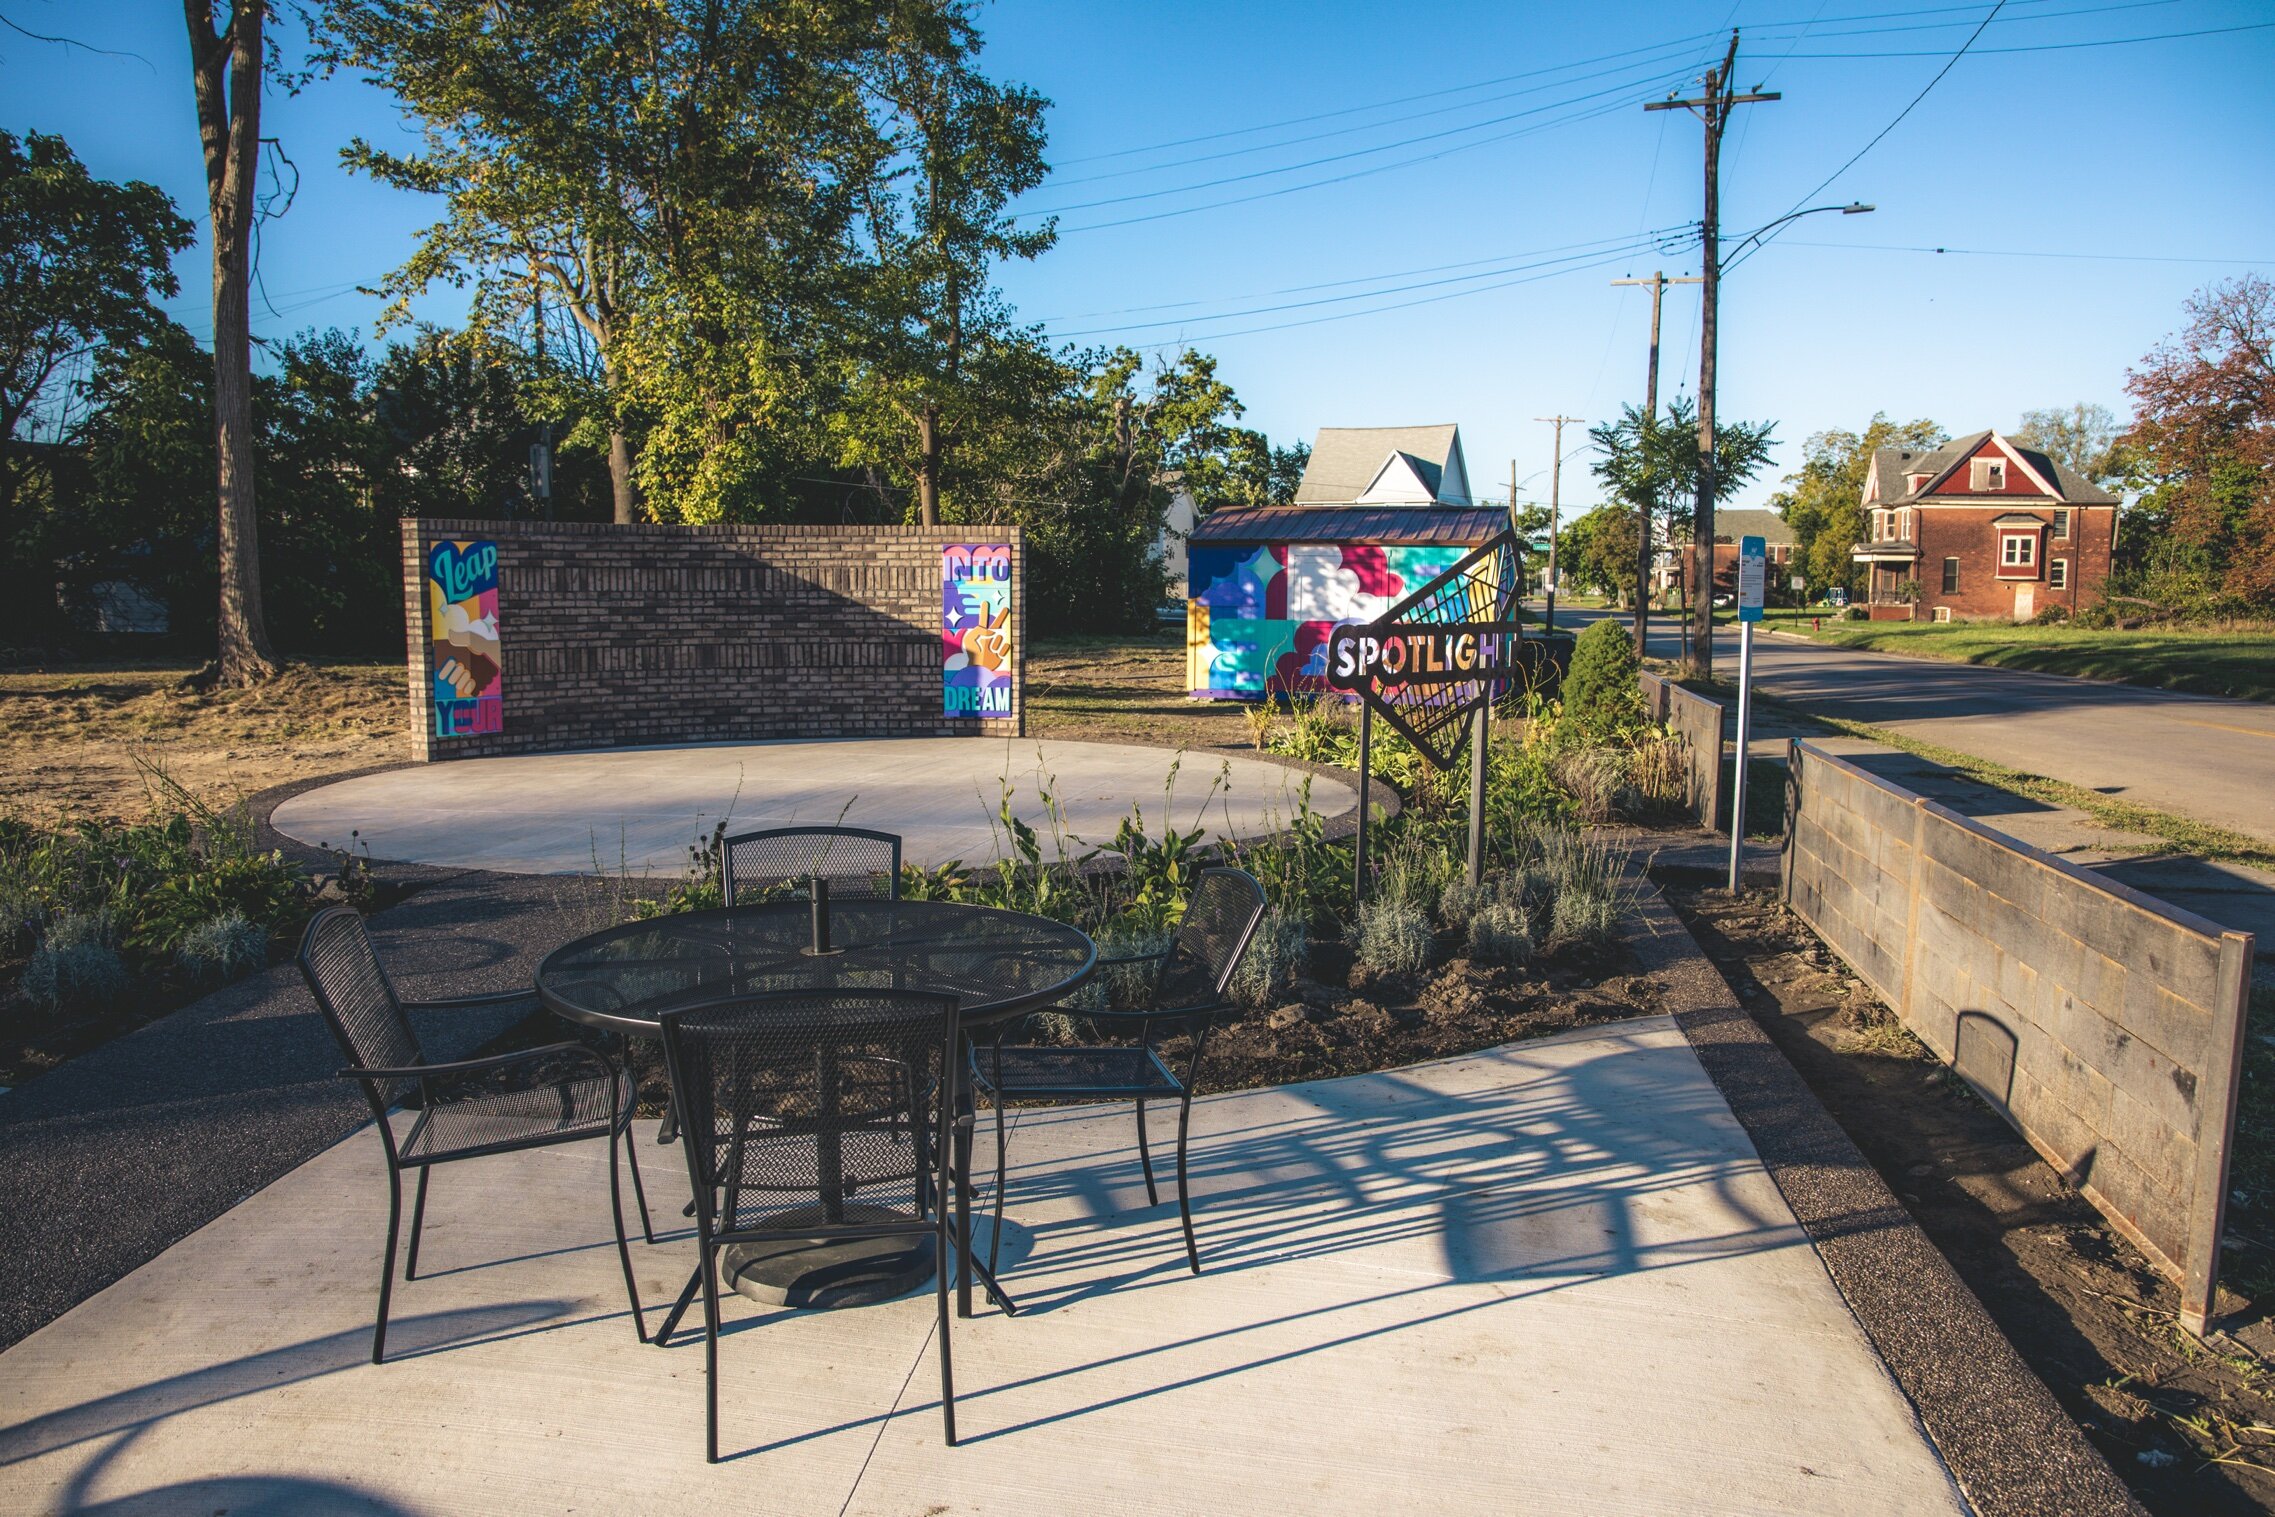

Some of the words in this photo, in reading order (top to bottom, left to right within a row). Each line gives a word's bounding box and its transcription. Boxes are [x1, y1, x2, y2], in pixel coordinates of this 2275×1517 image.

[434, 545, 497, 601] Leap
[944, 555, 1010, 582] INTO
[1335, 632, 1517, 678] SPOTLIGHT
[436, 699, 503, 735] YOUR
[944, 686, 1010, 712] DREAM
